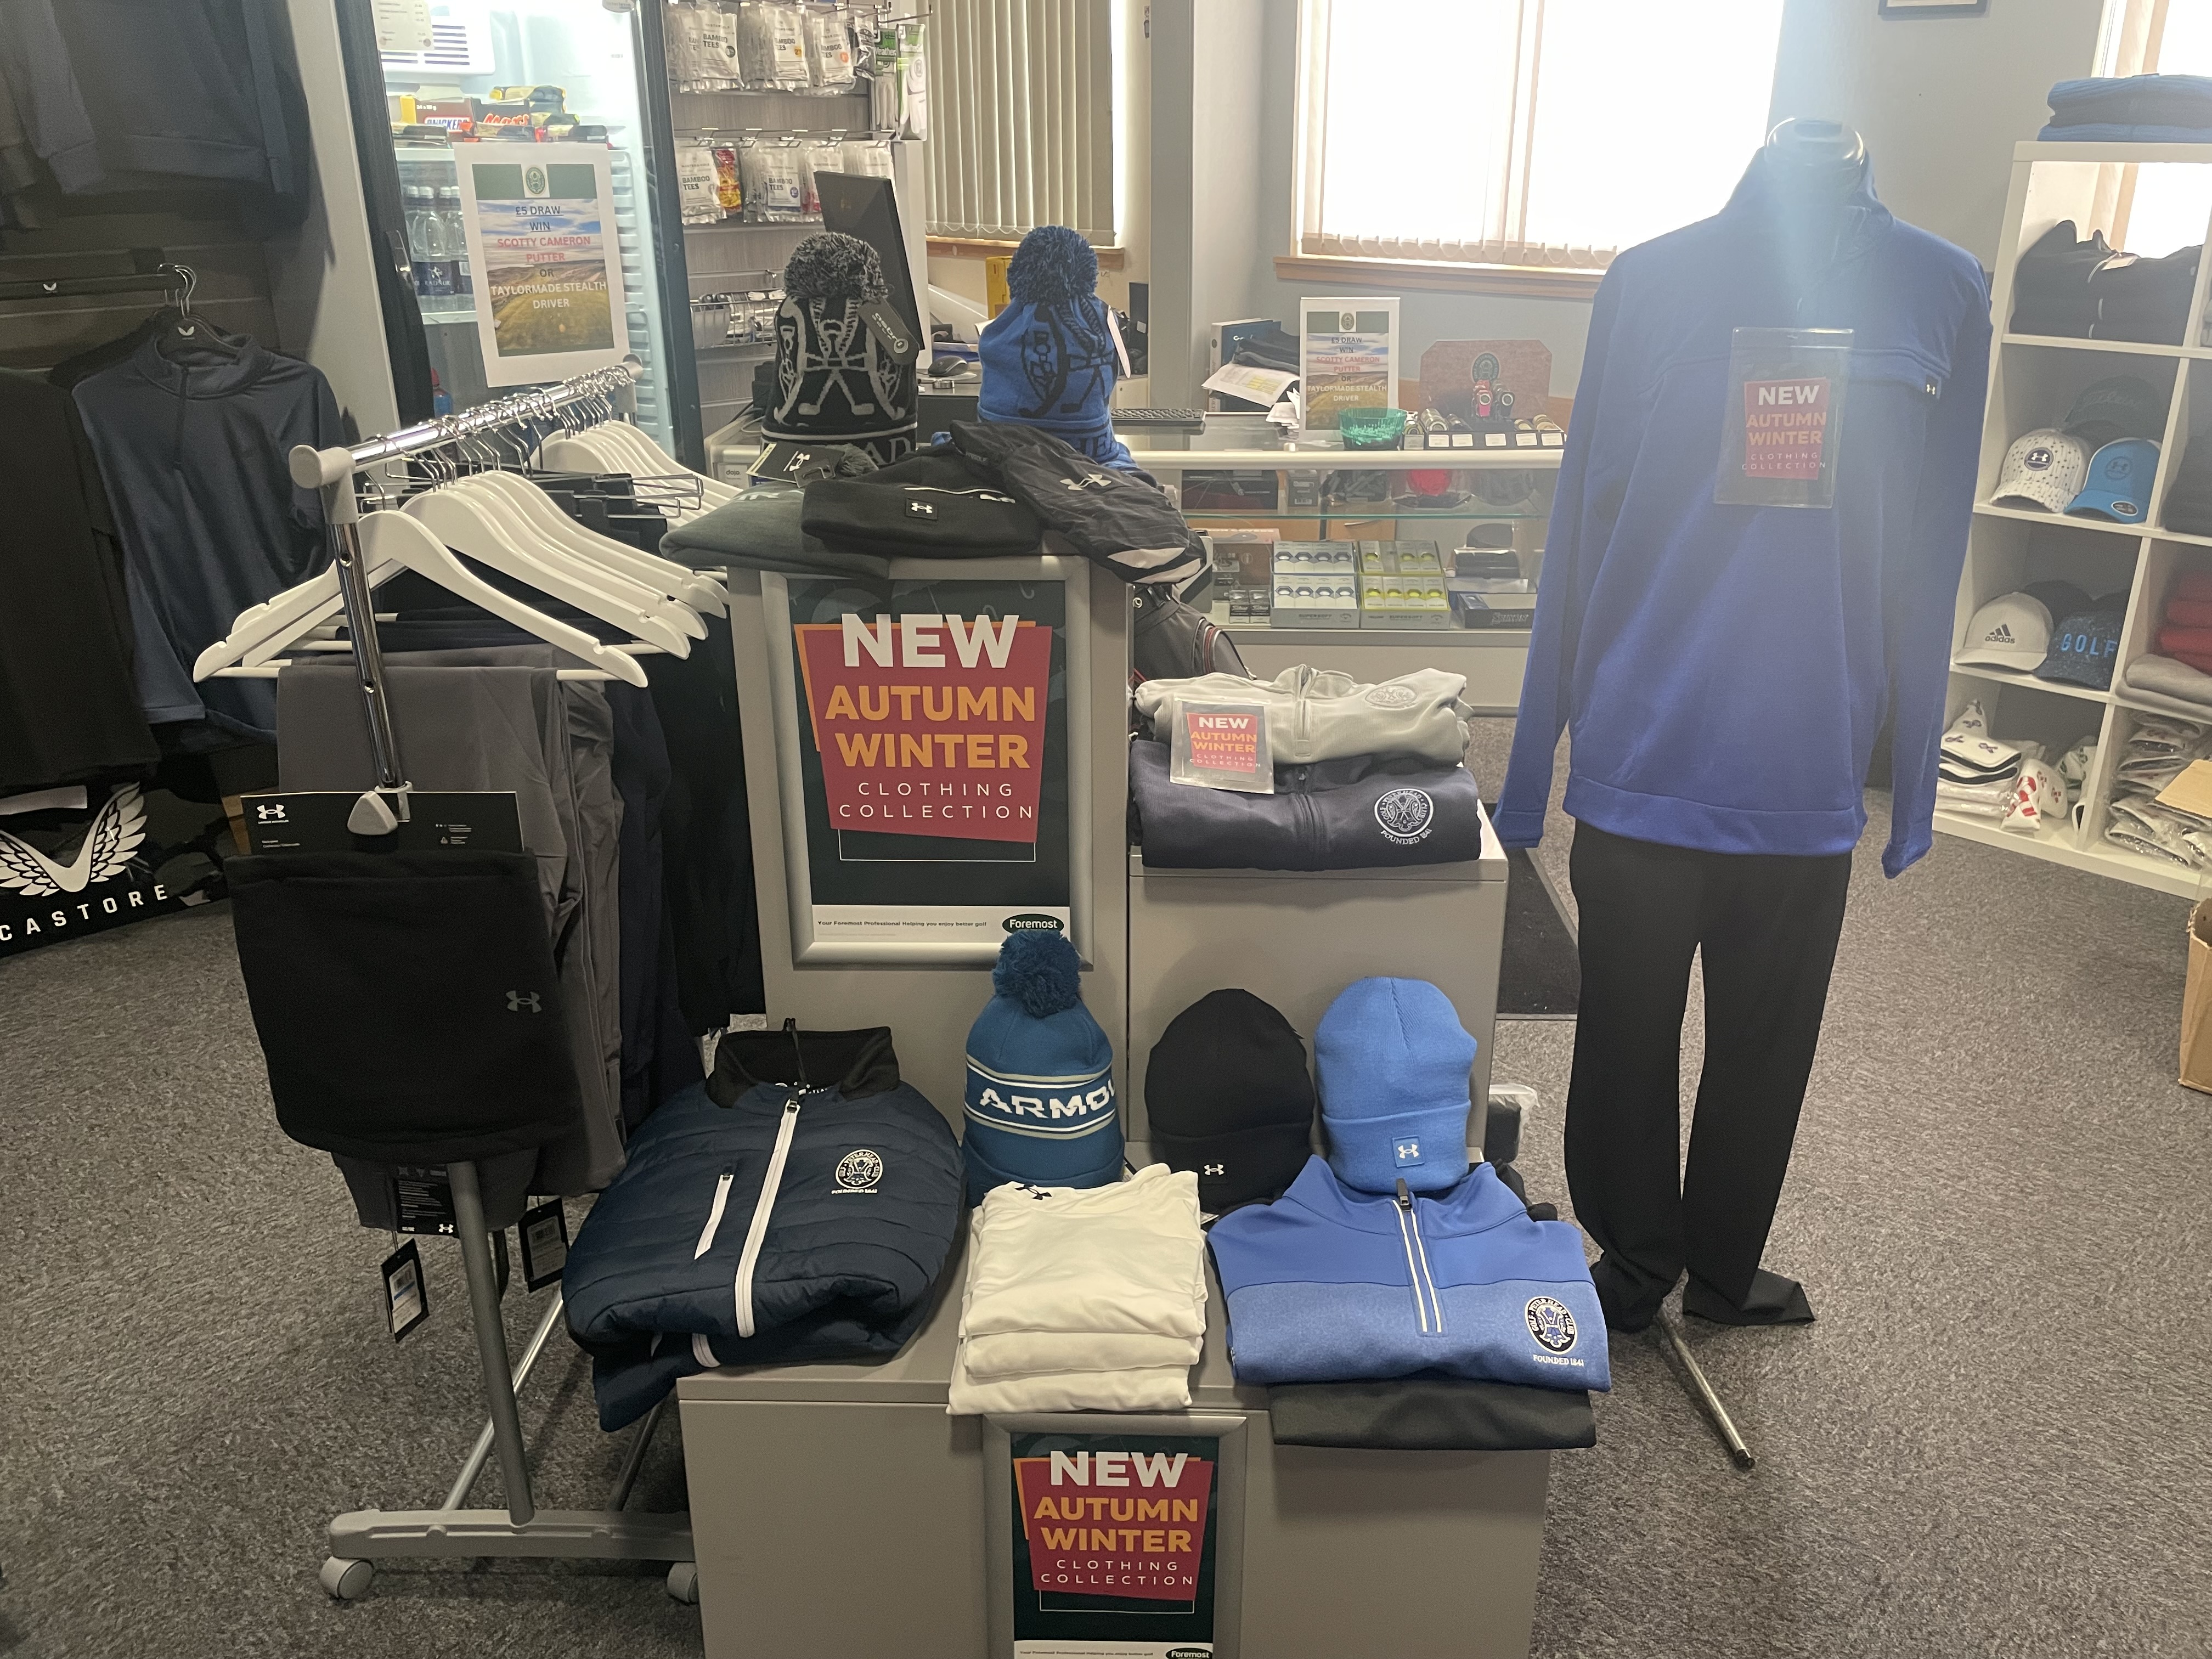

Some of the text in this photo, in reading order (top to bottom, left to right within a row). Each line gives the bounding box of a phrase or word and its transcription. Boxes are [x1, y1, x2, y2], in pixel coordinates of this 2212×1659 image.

[682, 176, 710, 184] BAMBOO
[515, 206, 561, 216] £5 DRAW
[529, 222, 551, 231] WIN
[497, 236, 591, 247] SCOTTY CAMERON
[526, 252, 566, 262] PUTTER
[539, 269, 555, 278] OR
[490, 281, 607, 296] TAYLORMADE STEALTH
[533, 298, 570, 309] DRIVER
[1758, 385, 1820, 405] NEW
[1746, 412, 1827, 428] AUTUMN
[1748, 430, 1822, 446] WINTER
[1751, 452, 1818, 460] CLOTHING
[1741, 462, 1826, 470] COLLECTION
[842, 613, 1019, 668] NEW
[1985, 635, 2015, 644] adidas
[2061, 633, 2118, 658] GOLF
[825, 685, 1035, 722] AUTUMN
[1199, 716, 1249, 729] NEW
[1190, 731, 1257, 742] AUTUMN
[835, 733, 1030, 769] WINTER
[1193, 741, 1256, 753] WINTER
[1189, 758, 1261, 768] COLLECTION
[857, 782, 1013, 797] CLOTHING
[839, 804, 1032, 819] COLLECTION
[1380, 830, 1420, 845] FOUNDED
[0, 884, 167, 941] CASTORE
[1009, 919, 1058, 929] Foremost
[1528, 1314, 1539, 1332] GOLF
[1533, 1354, 1570, 1365] FOUNDED
[1049, 1451, 1188, 1488] NEW
[1034, 1496, 1198, 1522] AUTUMN
[1041, 1527, 1192, 1552] WINTER
[1057, 1560, 1178, 1571] CLOTHING
[1041, 1573, 1193, 1585] COLLECTION
